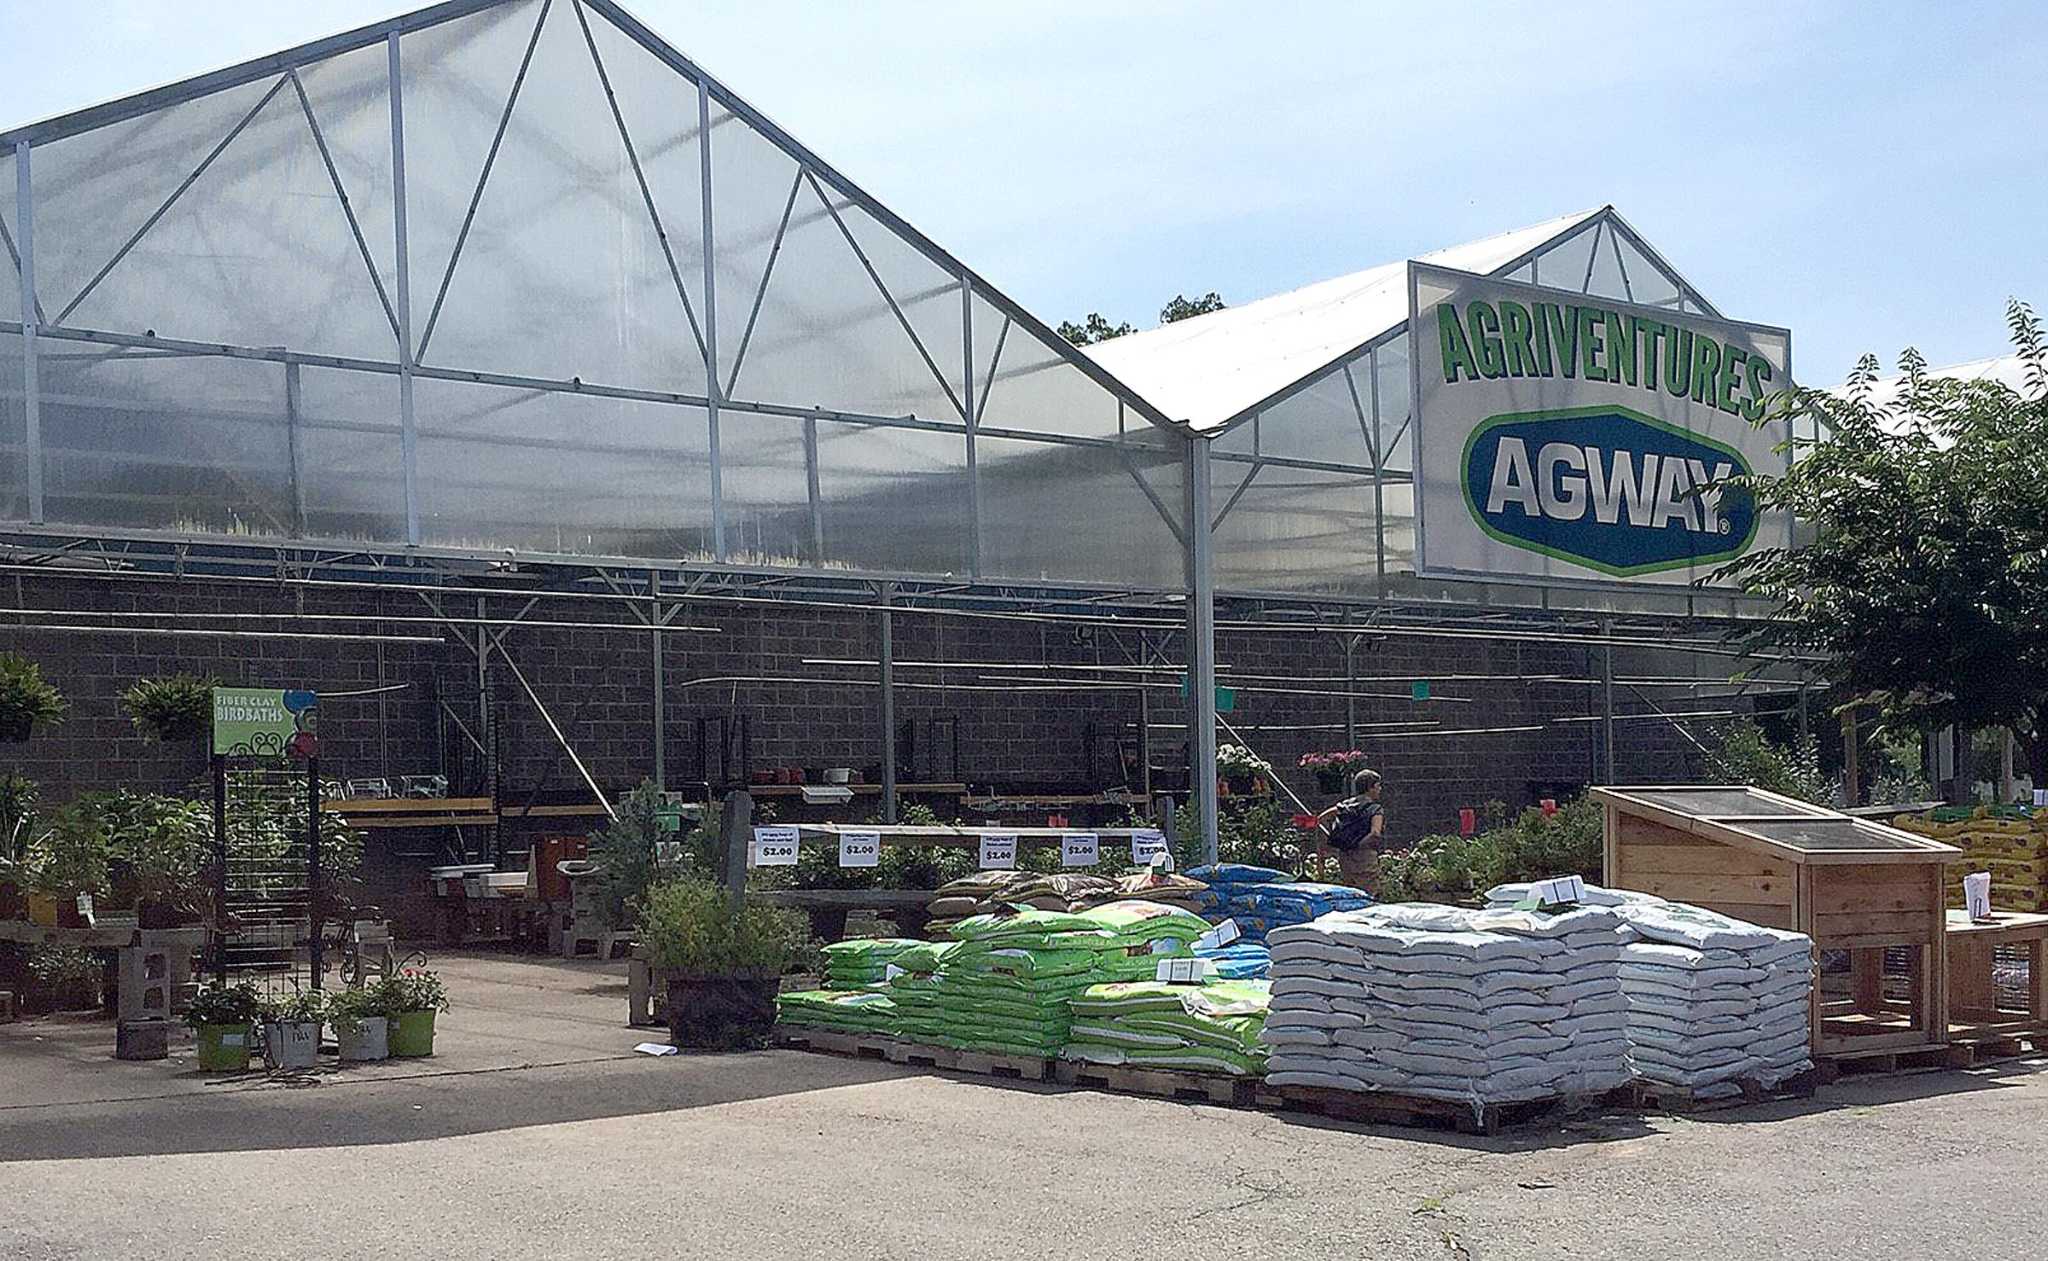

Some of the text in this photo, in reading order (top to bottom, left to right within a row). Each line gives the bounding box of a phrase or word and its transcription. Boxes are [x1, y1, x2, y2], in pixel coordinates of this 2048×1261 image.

[1436, 301, 1772, 422] AGRIVENTURES
[1486, 435, 1732, 534] AGWAY
[216, 696, 277, 706] FIBER CLAY
[216, 707, 283, 722] BIRDBATHS
[762, 846, 793, 857] $2.00
[846, 845, 874, 855] $2.00
[986, 850, 1012, 861] $2.00
[1068, 845, 1094, 855] $2.00
